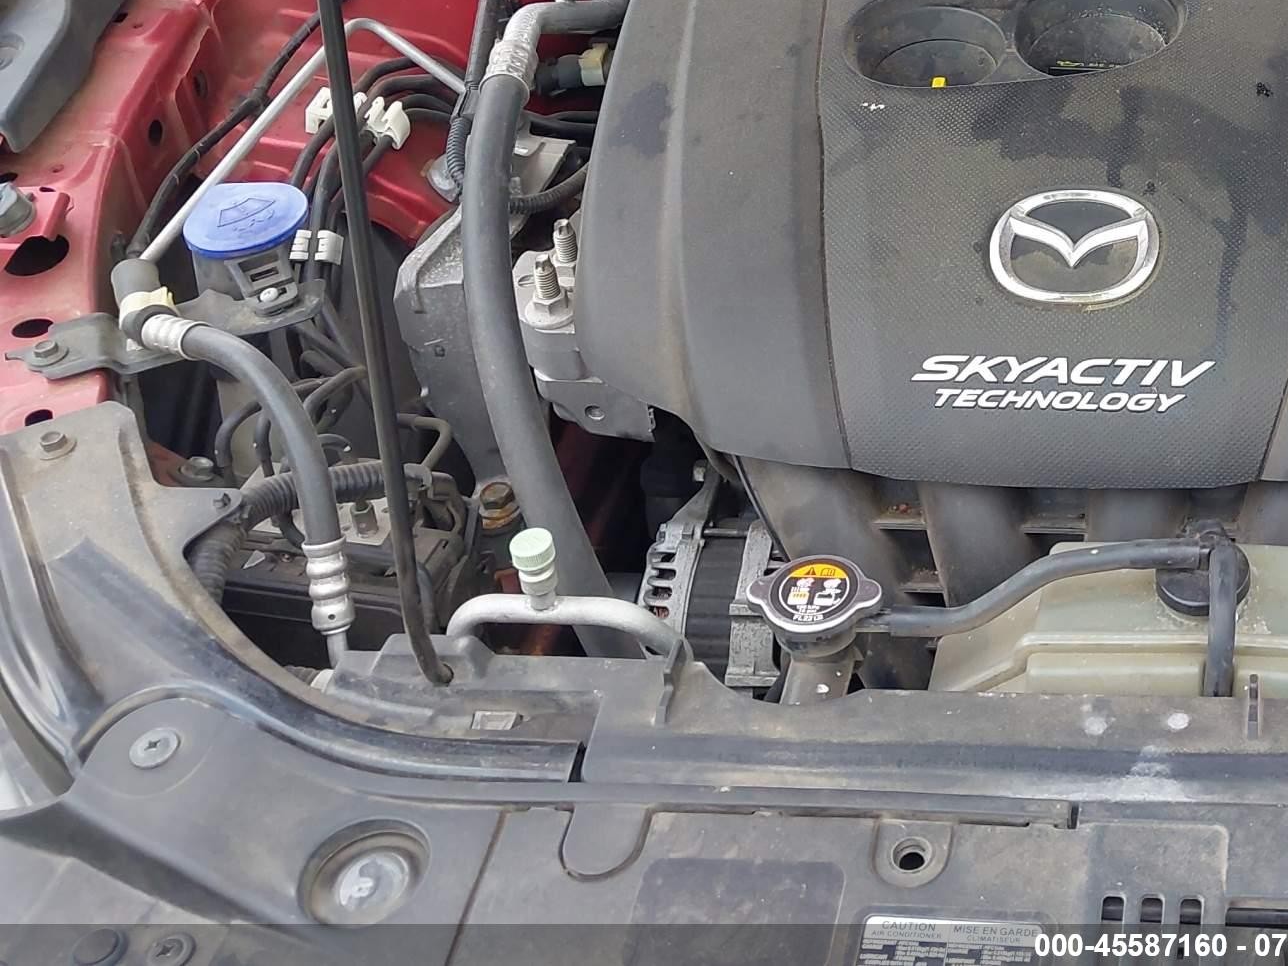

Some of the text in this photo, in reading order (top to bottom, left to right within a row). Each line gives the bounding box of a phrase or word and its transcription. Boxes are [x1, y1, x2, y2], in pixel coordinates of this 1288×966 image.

[911, 355, 1216, 387] SKYACTIV
[934, 388, 1187, 413] TECHNOLOGY
[882, 920, 936, 932] CAUTION
[953, 925, 1038, 938] MISE EN GARDE
[887, 931, 942, 940] CONDITIONER
[966, 935, 1021, 944] CLIMATISEUR
